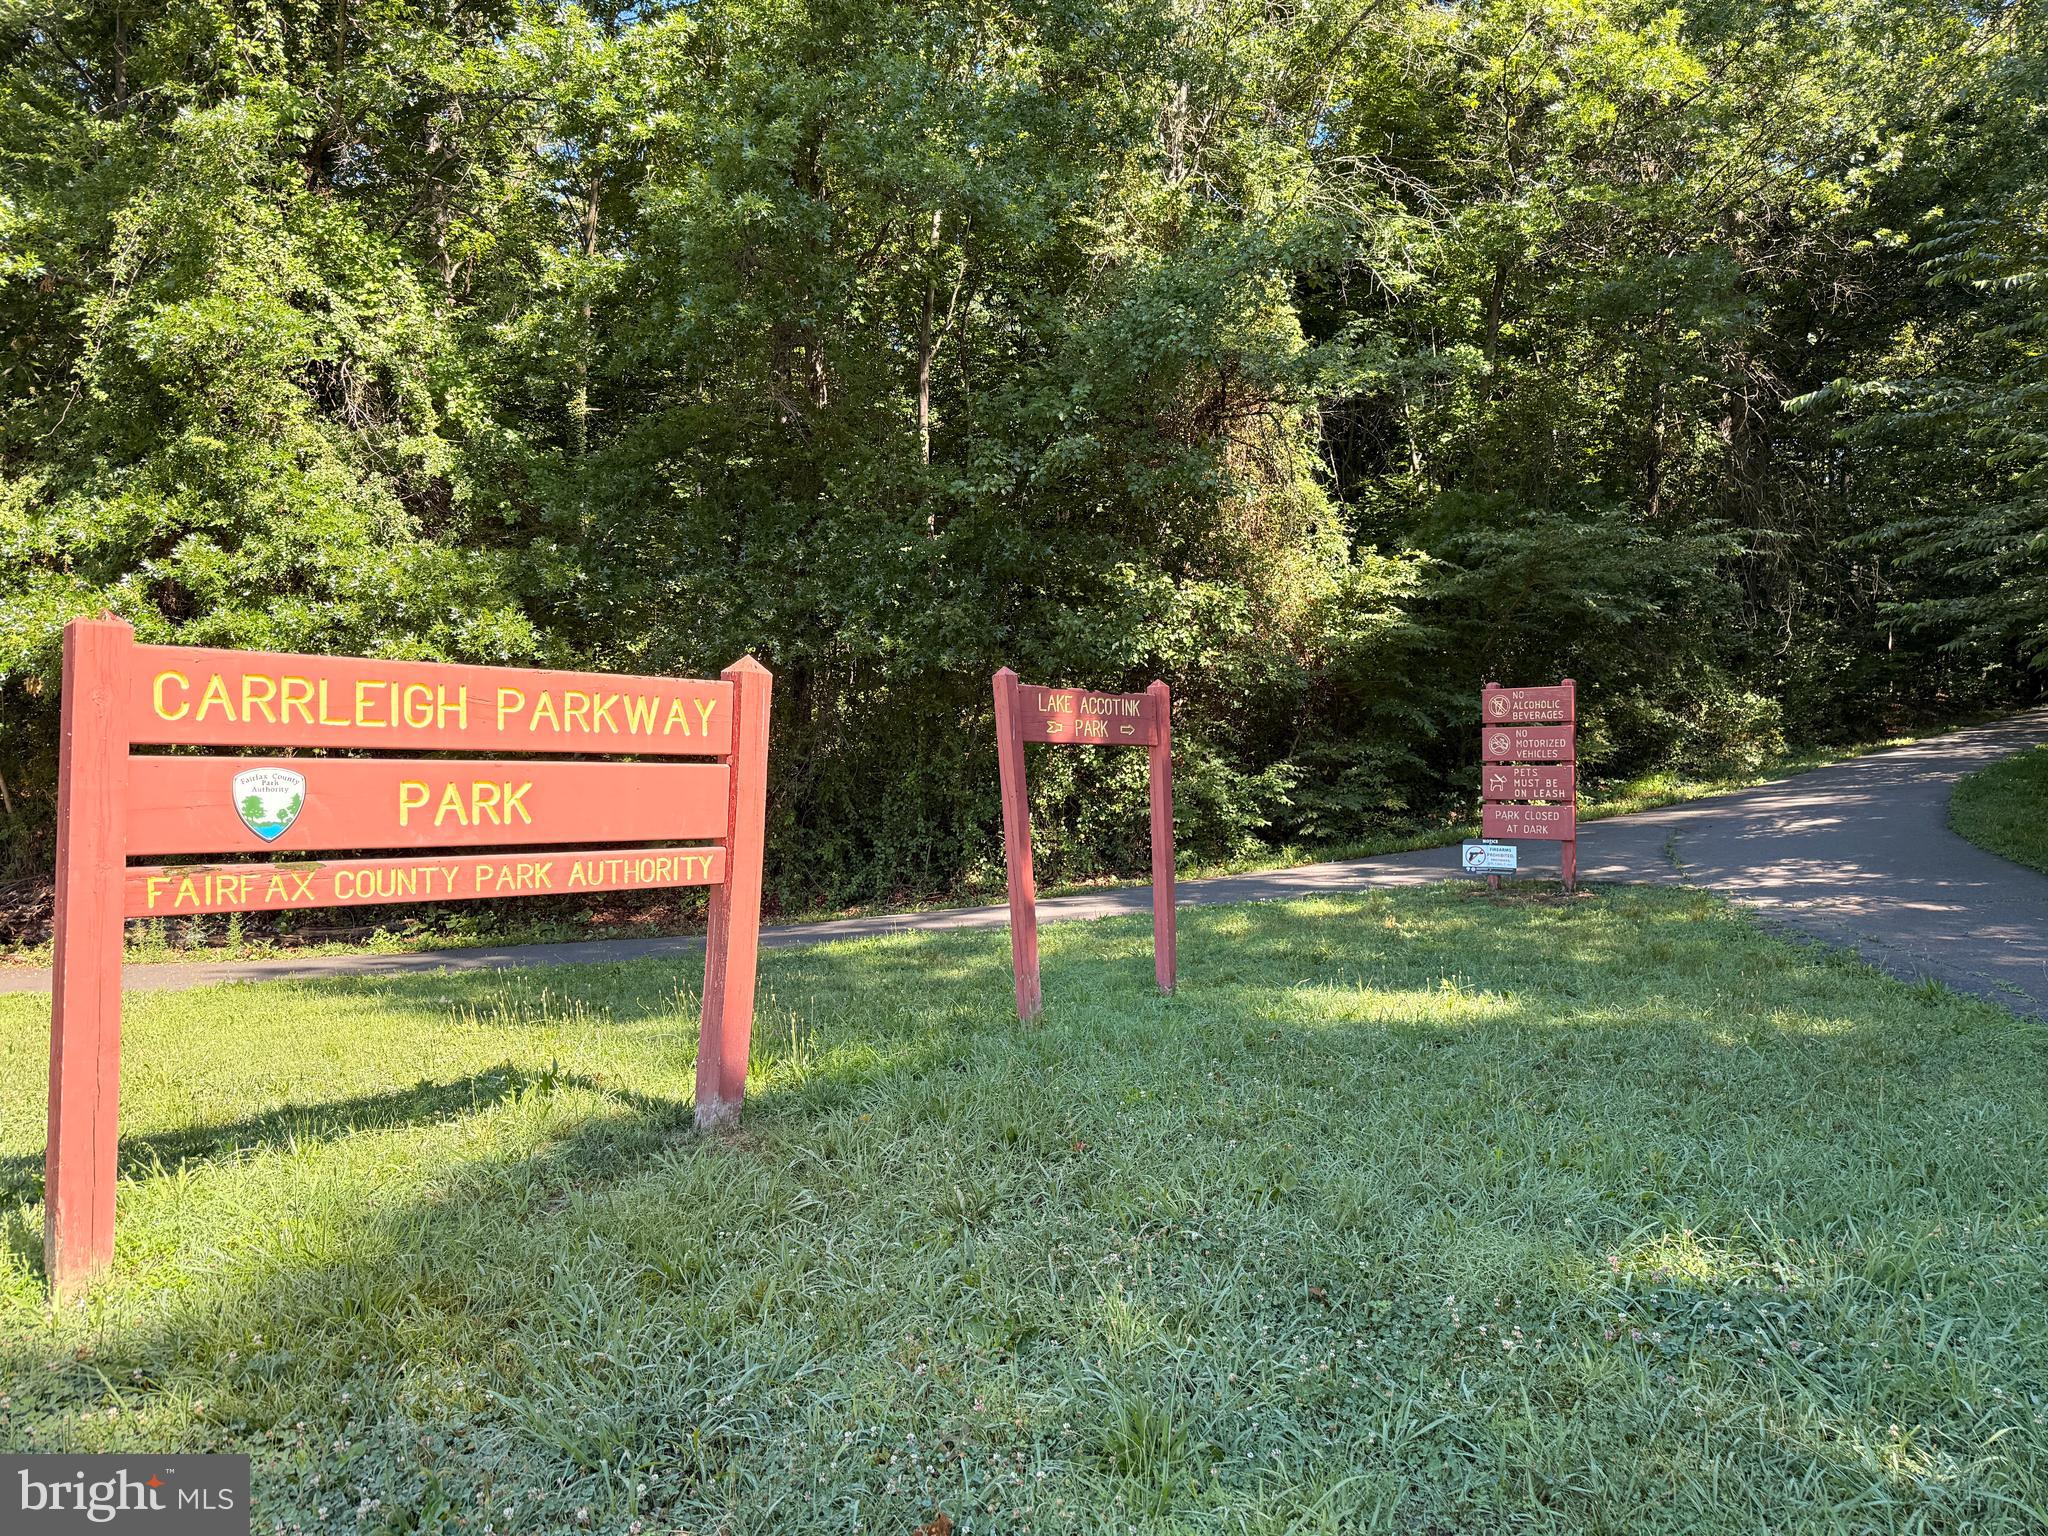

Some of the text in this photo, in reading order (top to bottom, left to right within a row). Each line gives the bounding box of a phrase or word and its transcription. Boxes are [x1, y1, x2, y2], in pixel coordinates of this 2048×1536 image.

[1512, 691, 1525, 699] NO
[152, 669, 718, 738] CARRLEIGH PARKWAY
[1038, 693, 1141, 717] LAKE ACCOTINK
[1512, 700, 1560, 710] ALCOHOLIC
[1512, 710, 1564, 720] BEVERAGES
[1075, 720, 1109, 737] PARK
[1516, 730, 1528, 738] NO
[1516, 739, 1566, 748] MOTORIZED
[1516, 750, 1558, 758] VEHICLES
[1513, 769, 1538, 777] PETS
[240, 773, 300, 786] Fairfax County
[1513, 779, 1559, 788] MUST BE
[1514, 789, 1565, 798] ON LEASH
[400, 780, 533, 828] PARK
[1495, 811, 1560, 821] PARK CLOSED
[1506, 824, 1549, 834] AT DARK
[147, 855, 714, 909] FAIRFAX COUNTY PARK AUTHORITY
